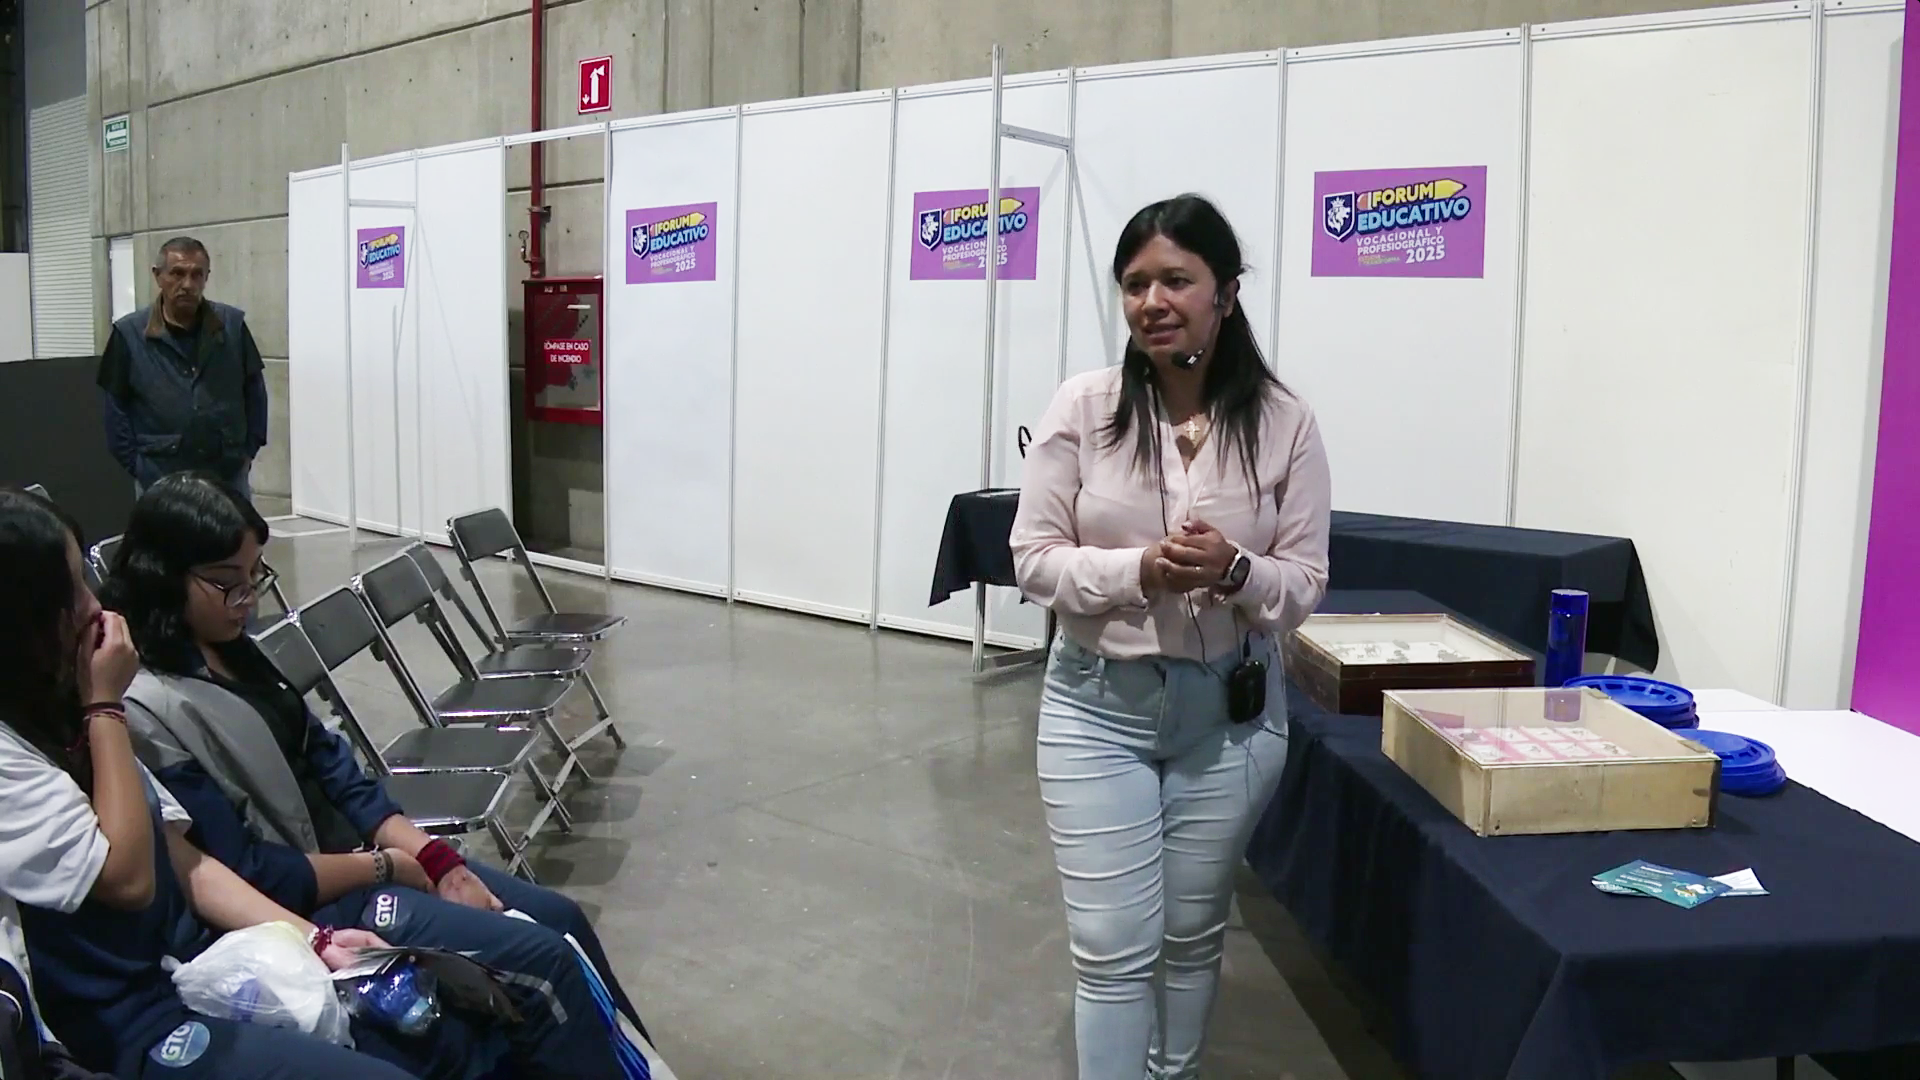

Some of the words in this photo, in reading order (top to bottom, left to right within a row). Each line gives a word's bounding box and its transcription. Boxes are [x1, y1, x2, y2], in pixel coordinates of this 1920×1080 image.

[1372, 182, 1434, 207] FORUM
[954, 203, 989, 222] FORU
[1357, 197, 1470, 231] EDUCATIVO
[658, 214, 690, 234] FORUM
[943, 213, 1027, 242] EDUCAIVO
[650, 225, 708, 251] EDUCATIVO
[942, 239, 987, 255] VOCACION
[1356, 228, 1431, 246] VOCACIONAL
[1435, 226, 1443, 235] Y
[676, 258, 696, 272] 2025
[1405, 245, 1445, 264] 2025
[375, 894, 393, 927] GTO
[161, 1025, 191, 1061] GTO
